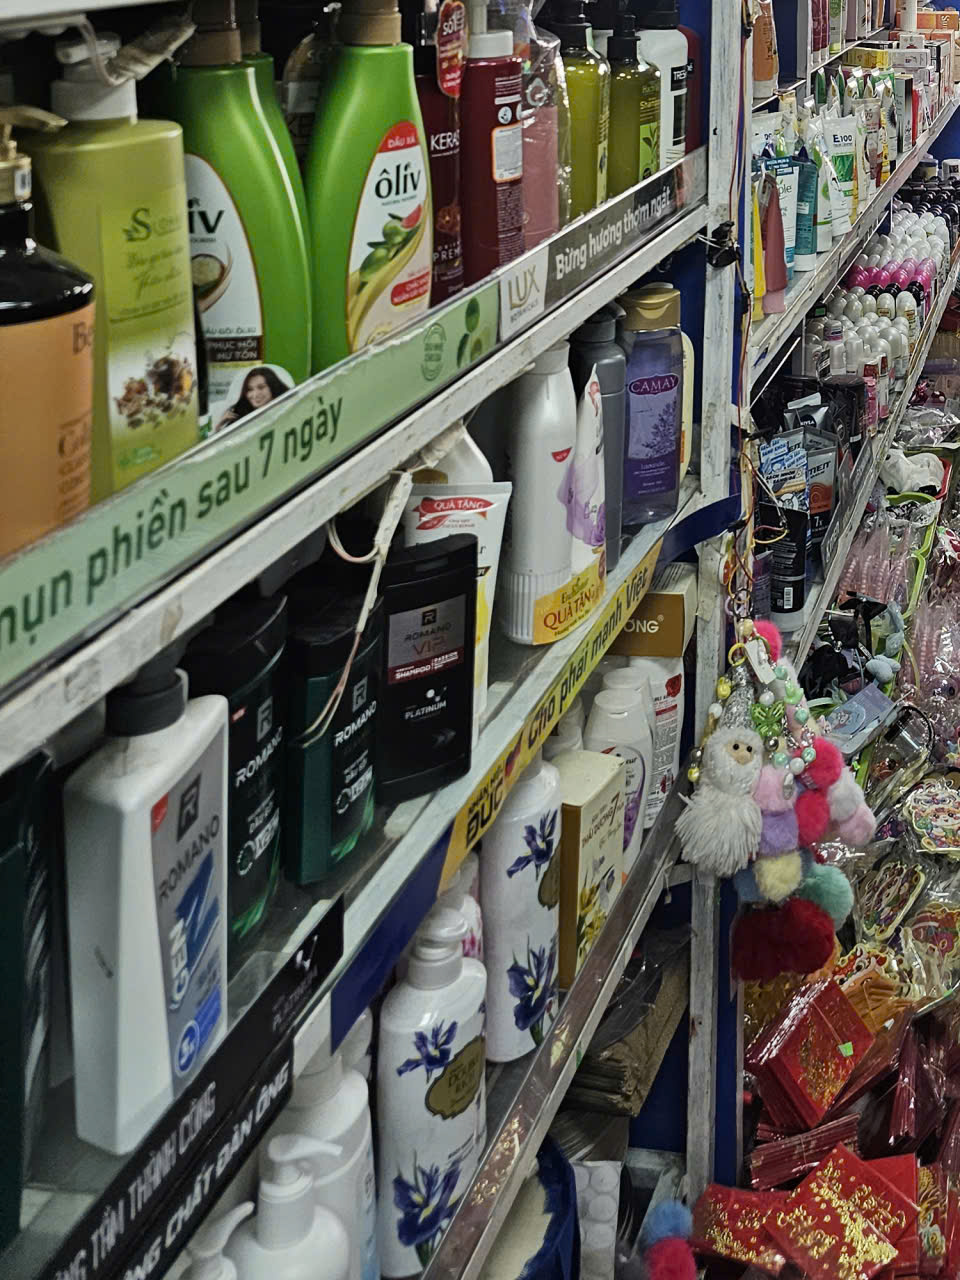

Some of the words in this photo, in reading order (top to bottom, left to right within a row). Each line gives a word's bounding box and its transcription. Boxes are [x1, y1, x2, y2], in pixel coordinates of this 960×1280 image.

[430, 129, 460, 152] KERA
[778, 184, 793, 195] ple
[554, 242, 588, 281] Bừng
[588, 222, 623, 258] hương
[650, 185, 671, 219] ngát
[508, 263, 540, 312] LUX
[630, 376, 676, 394] CAMAY
[85, 488, 189, 607] phiền
[196, 455, 252, 521] sau
[258, 430, 275, 479] 7
[282, 395, 344, 466] ngày
[434, 500, 456, 511] QUÀ
[543, 600, 573, 630] QUÀ
[395, 664, 432, 679] SHAMPOO
[334, 700, 377, 748] ROMANO
[235, 725, 284, 789] ROMANO
[158, 814, 220, 900] ROMANO
[214, 1118, 254, 1181] ĐÀN
[254, 1061, 290, 1121] ÔNG
